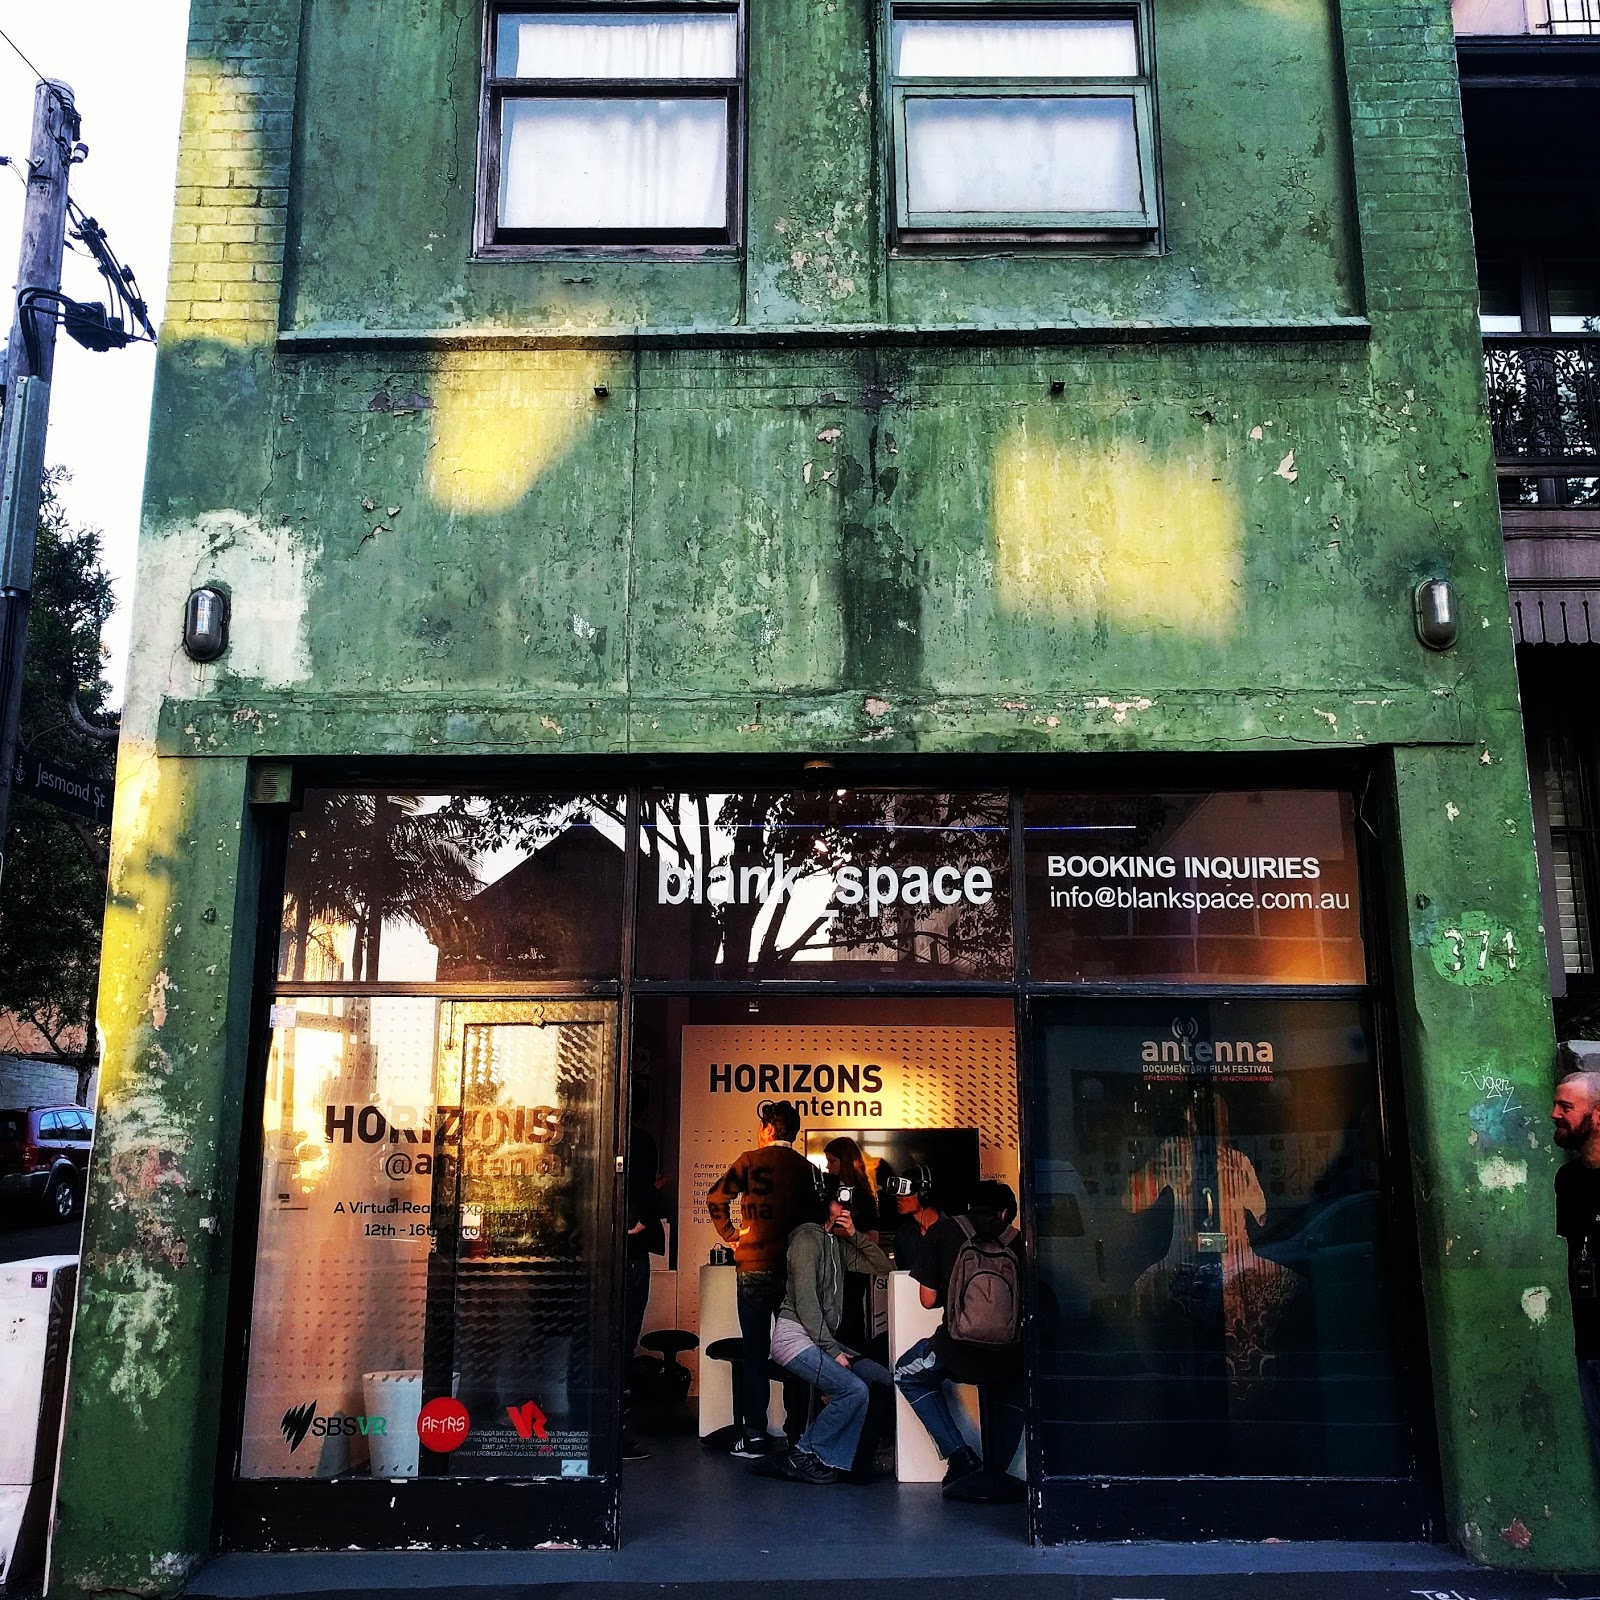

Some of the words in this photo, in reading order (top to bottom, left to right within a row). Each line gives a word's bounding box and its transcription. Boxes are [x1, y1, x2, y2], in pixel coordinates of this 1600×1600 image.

[35, 762, 90, 802] Jesmond
[93, 786, 106, 808] St
[1048, 855, 1176, 878] BOOKING
[1185, 857, 1321, 880] INQUIRIES
[1050, 886, 1350, 914] info@blankspace.com.au
[1443, 928, 1520, 973] 374
[1141, 1036, 1274, 1062] antenna
[710, 1064, 883, 1093] HORIZONS
[1209, 1064, 1231, 1074] FILM
[1232, 1064, 1274, 1074] FESTIVAL
[325, 1105, 559, 1144] HORIZONS
[334, 1202, 345, 1214] A
[349, 1202, 398, 1214] Virtual
[364, 1224, 396, 1236] 12th
[421, 1415, 466, 1434] AFTRS
